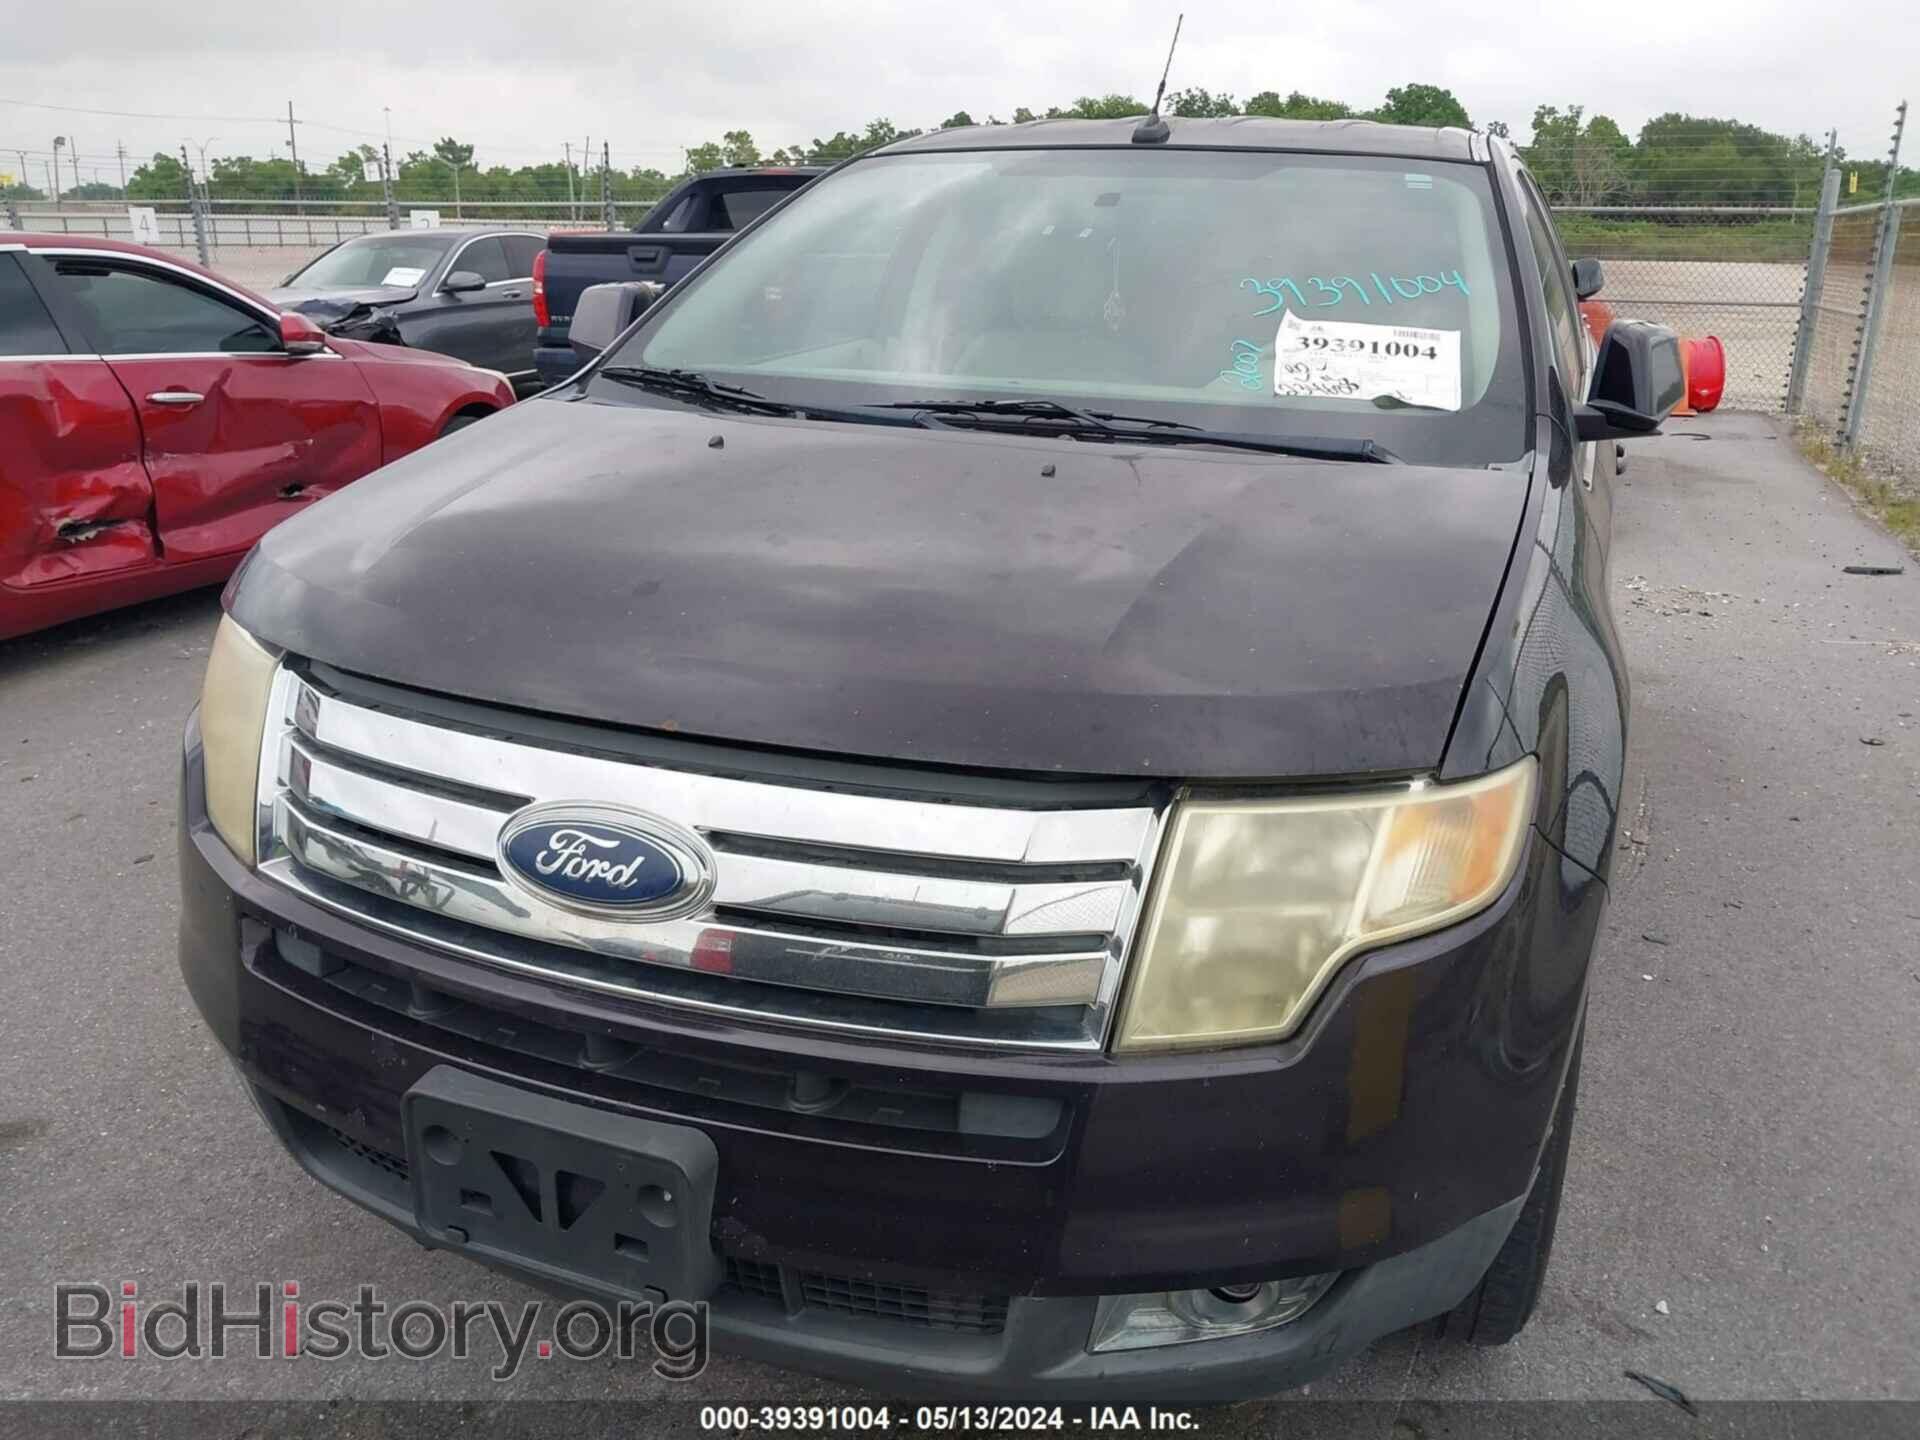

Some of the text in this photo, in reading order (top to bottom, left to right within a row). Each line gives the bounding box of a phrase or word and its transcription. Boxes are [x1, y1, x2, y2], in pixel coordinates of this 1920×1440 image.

[1239, 269, 1471, 317] 39391004
[1296, 335, 1438, 361] 39391004
[535, 828, 645, 889] Ford
